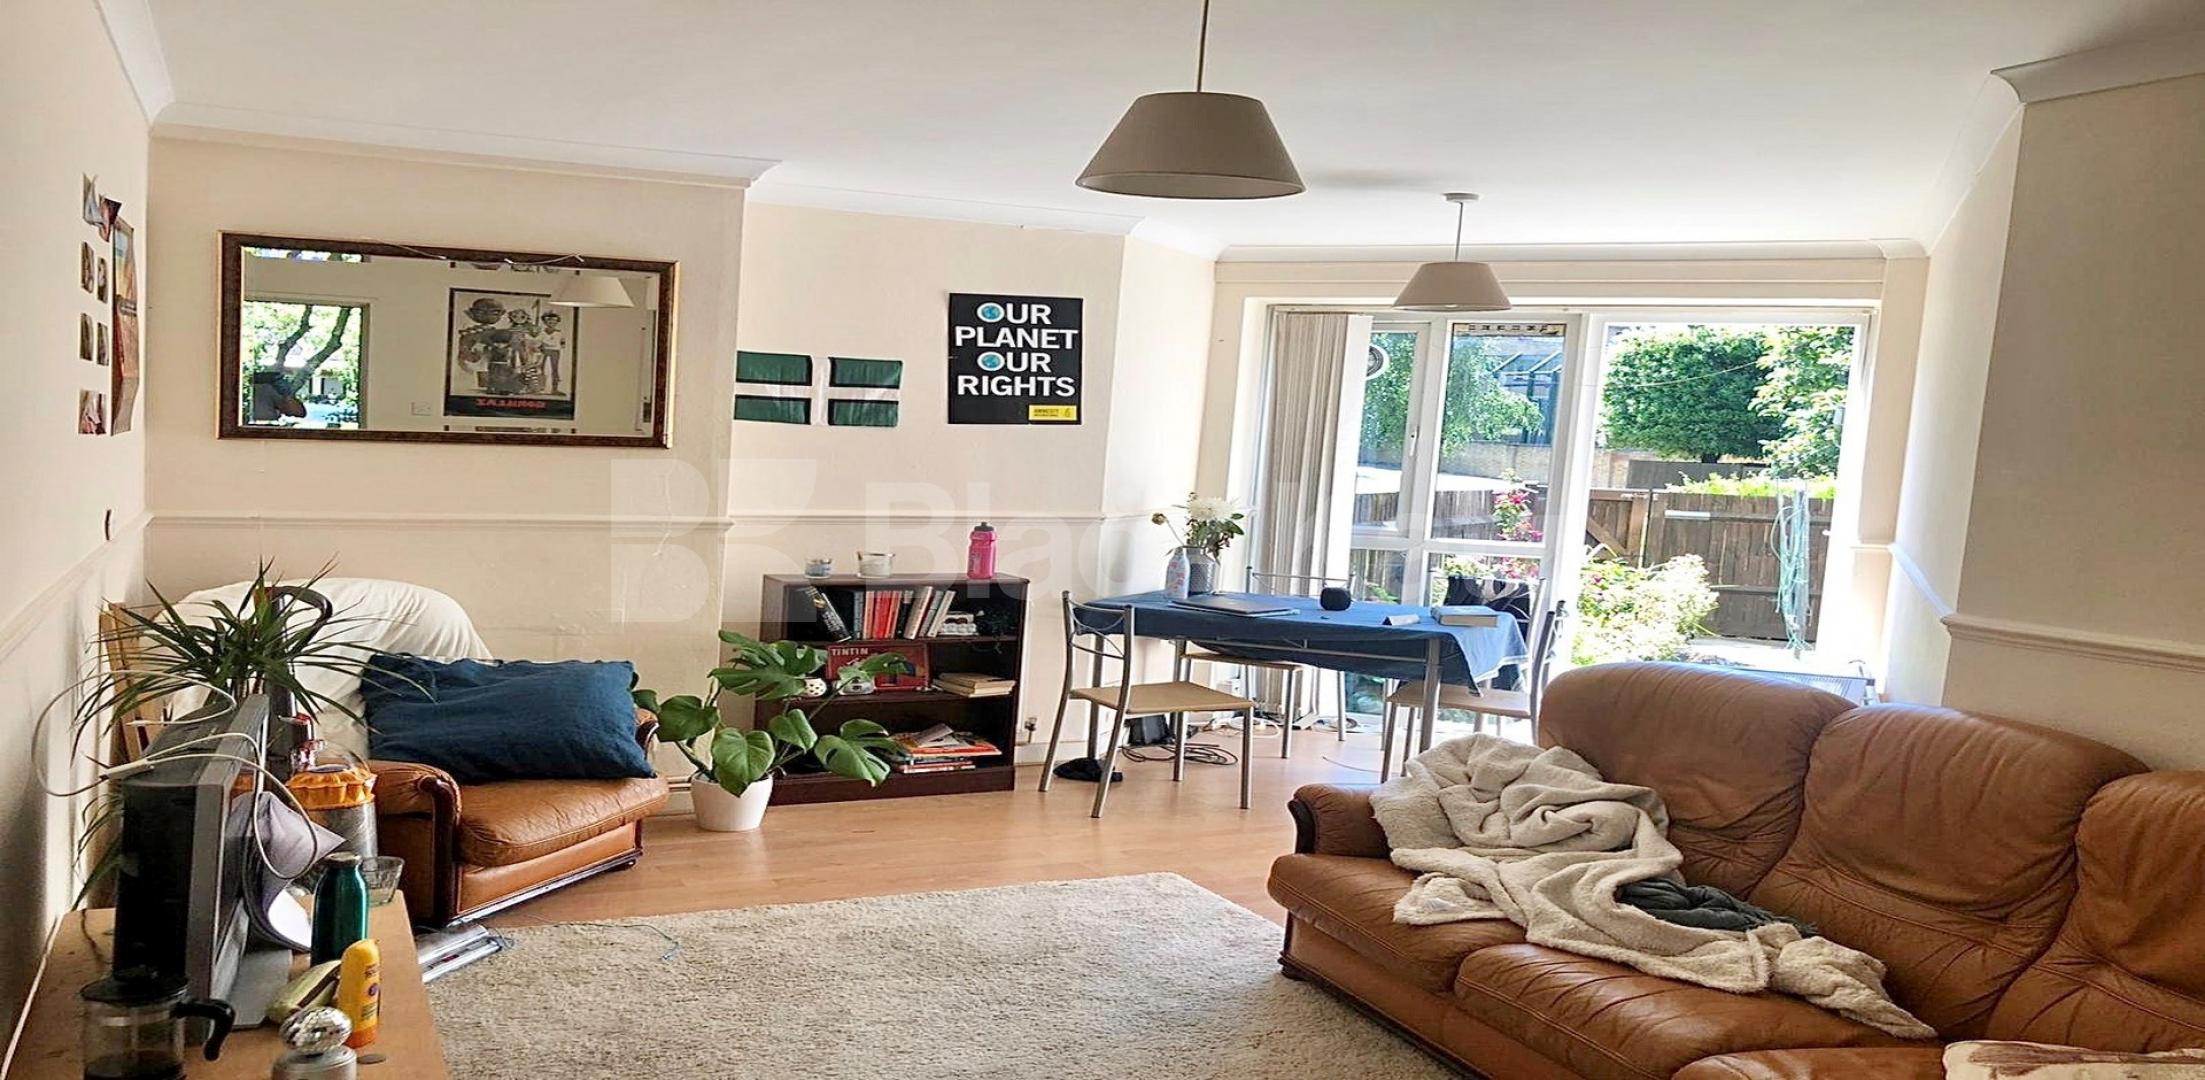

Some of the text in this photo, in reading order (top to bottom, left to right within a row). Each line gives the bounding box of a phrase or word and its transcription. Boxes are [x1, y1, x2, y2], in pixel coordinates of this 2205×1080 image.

[976, 302, 1052, 325] OUR
[954, 326, 1079, 350] PLANET
[976, 351, 1052, 373] OUR
[957, 375, 1076, 397] RIGHTS
[831, 647, 869, 656] TINTIN
